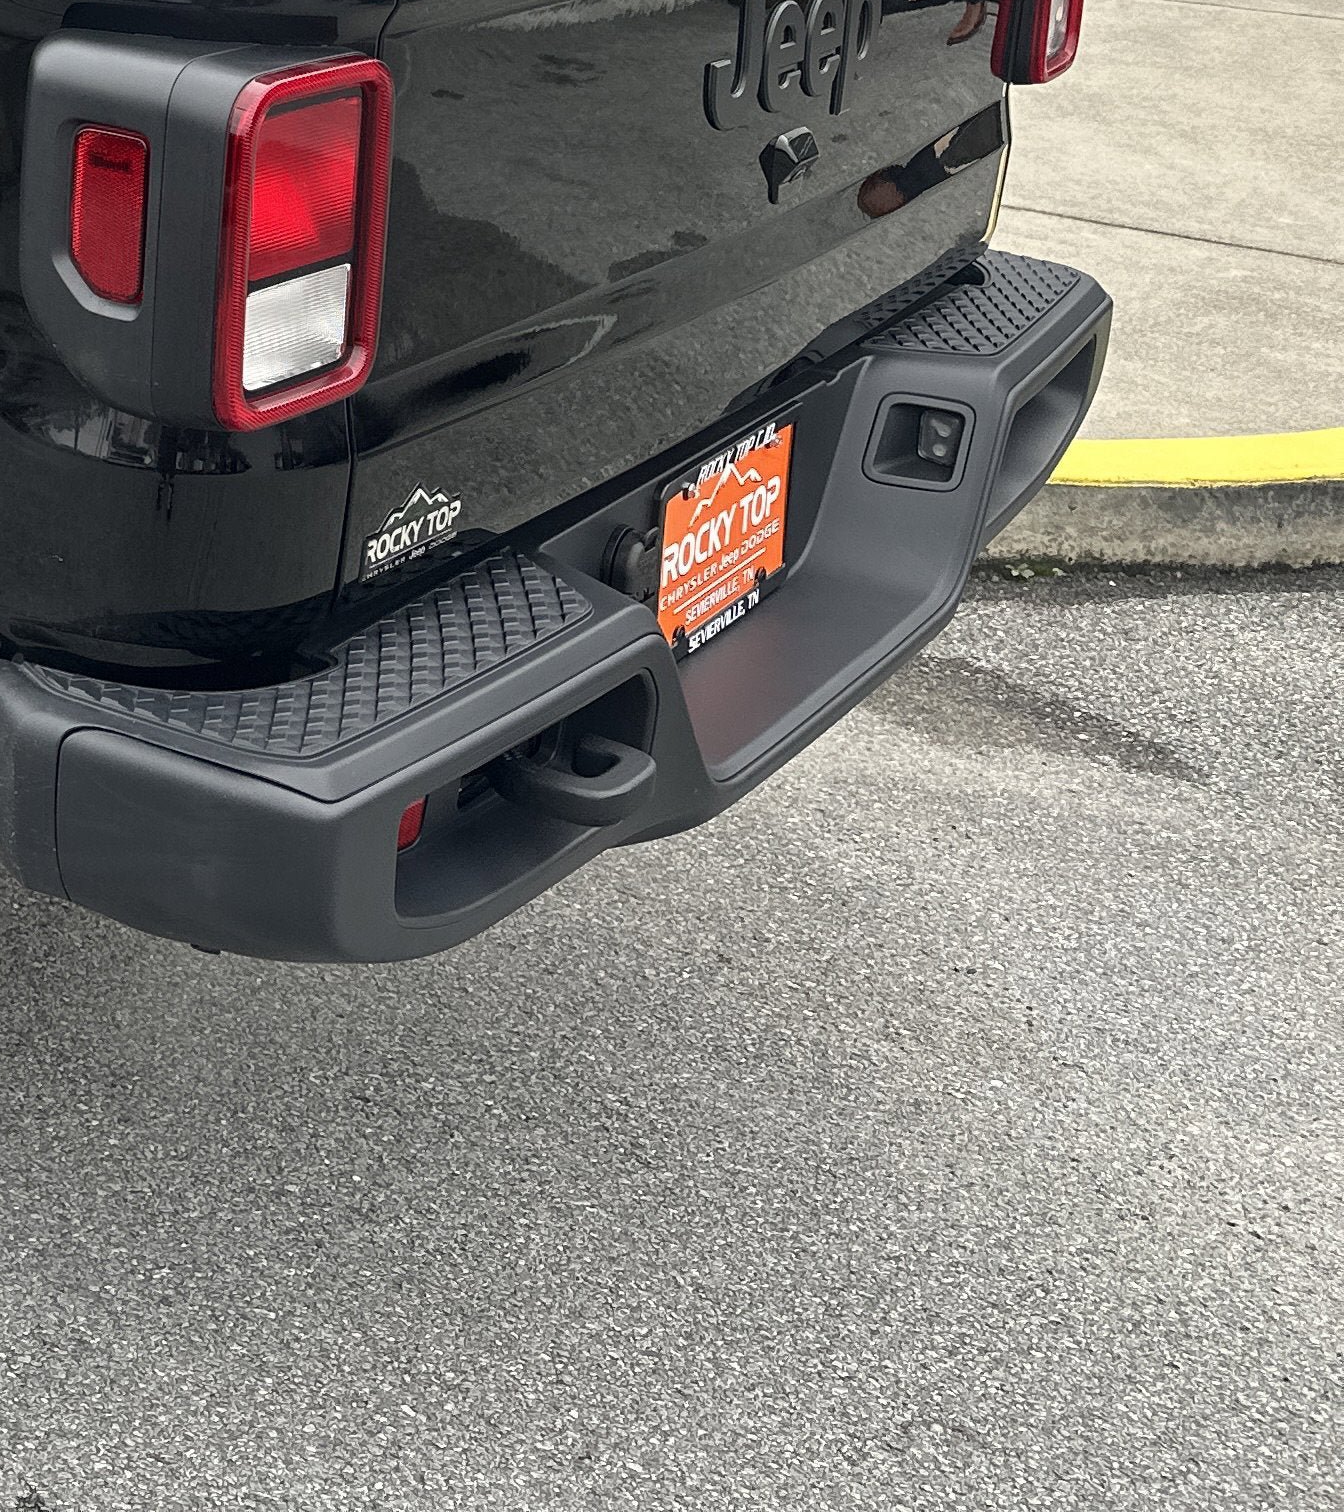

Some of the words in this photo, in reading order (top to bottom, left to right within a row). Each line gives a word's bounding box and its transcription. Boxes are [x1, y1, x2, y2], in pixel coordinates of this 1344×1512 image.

[364, 516, 425, 566] ROCKY
[426, 500, 462, 536] TOP
[659, 503, 737, 588] ROCKY
[739, 475, 781, 535] TOP
[659, 562, 718, 612] CHRYSLER
[740, 517, 781, 555] DODGE
[747, 588, 760, 610] TN
